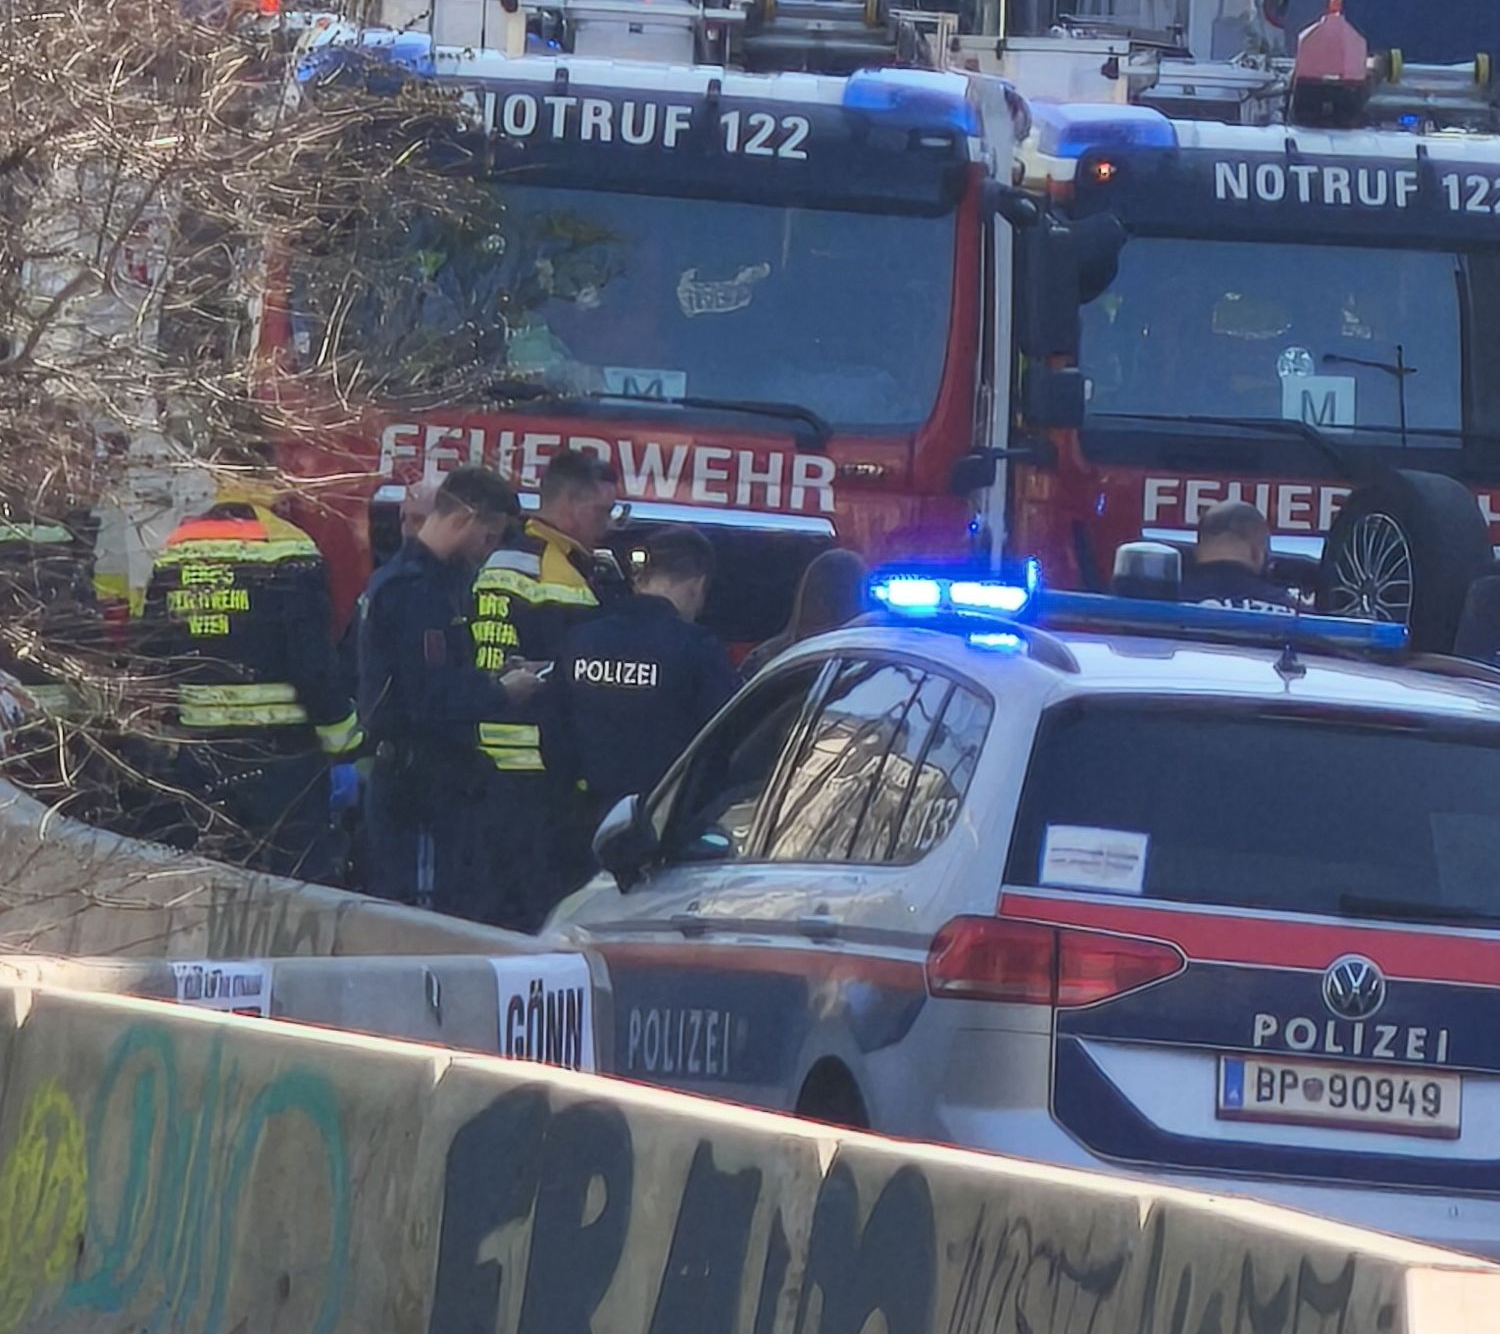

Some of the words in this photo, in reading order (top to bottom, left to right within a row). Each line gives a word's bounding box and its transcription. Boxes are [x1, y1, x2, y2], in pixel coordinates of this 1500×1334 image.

[720, 109, 812, 160] 122
[1214, 161, 1419, 208] NOTRUF
[1301, 389, 1336, 426] M
[573, 658, 657, 687] POLIZEI
[627, 1008, 731, 1077] POLIZEI
[1253, 1013, 1448, 1063] POLIZEI
[1256, 1066, 1299, 1105] BP
[1328, 1073, 1442, 1119] 90949
